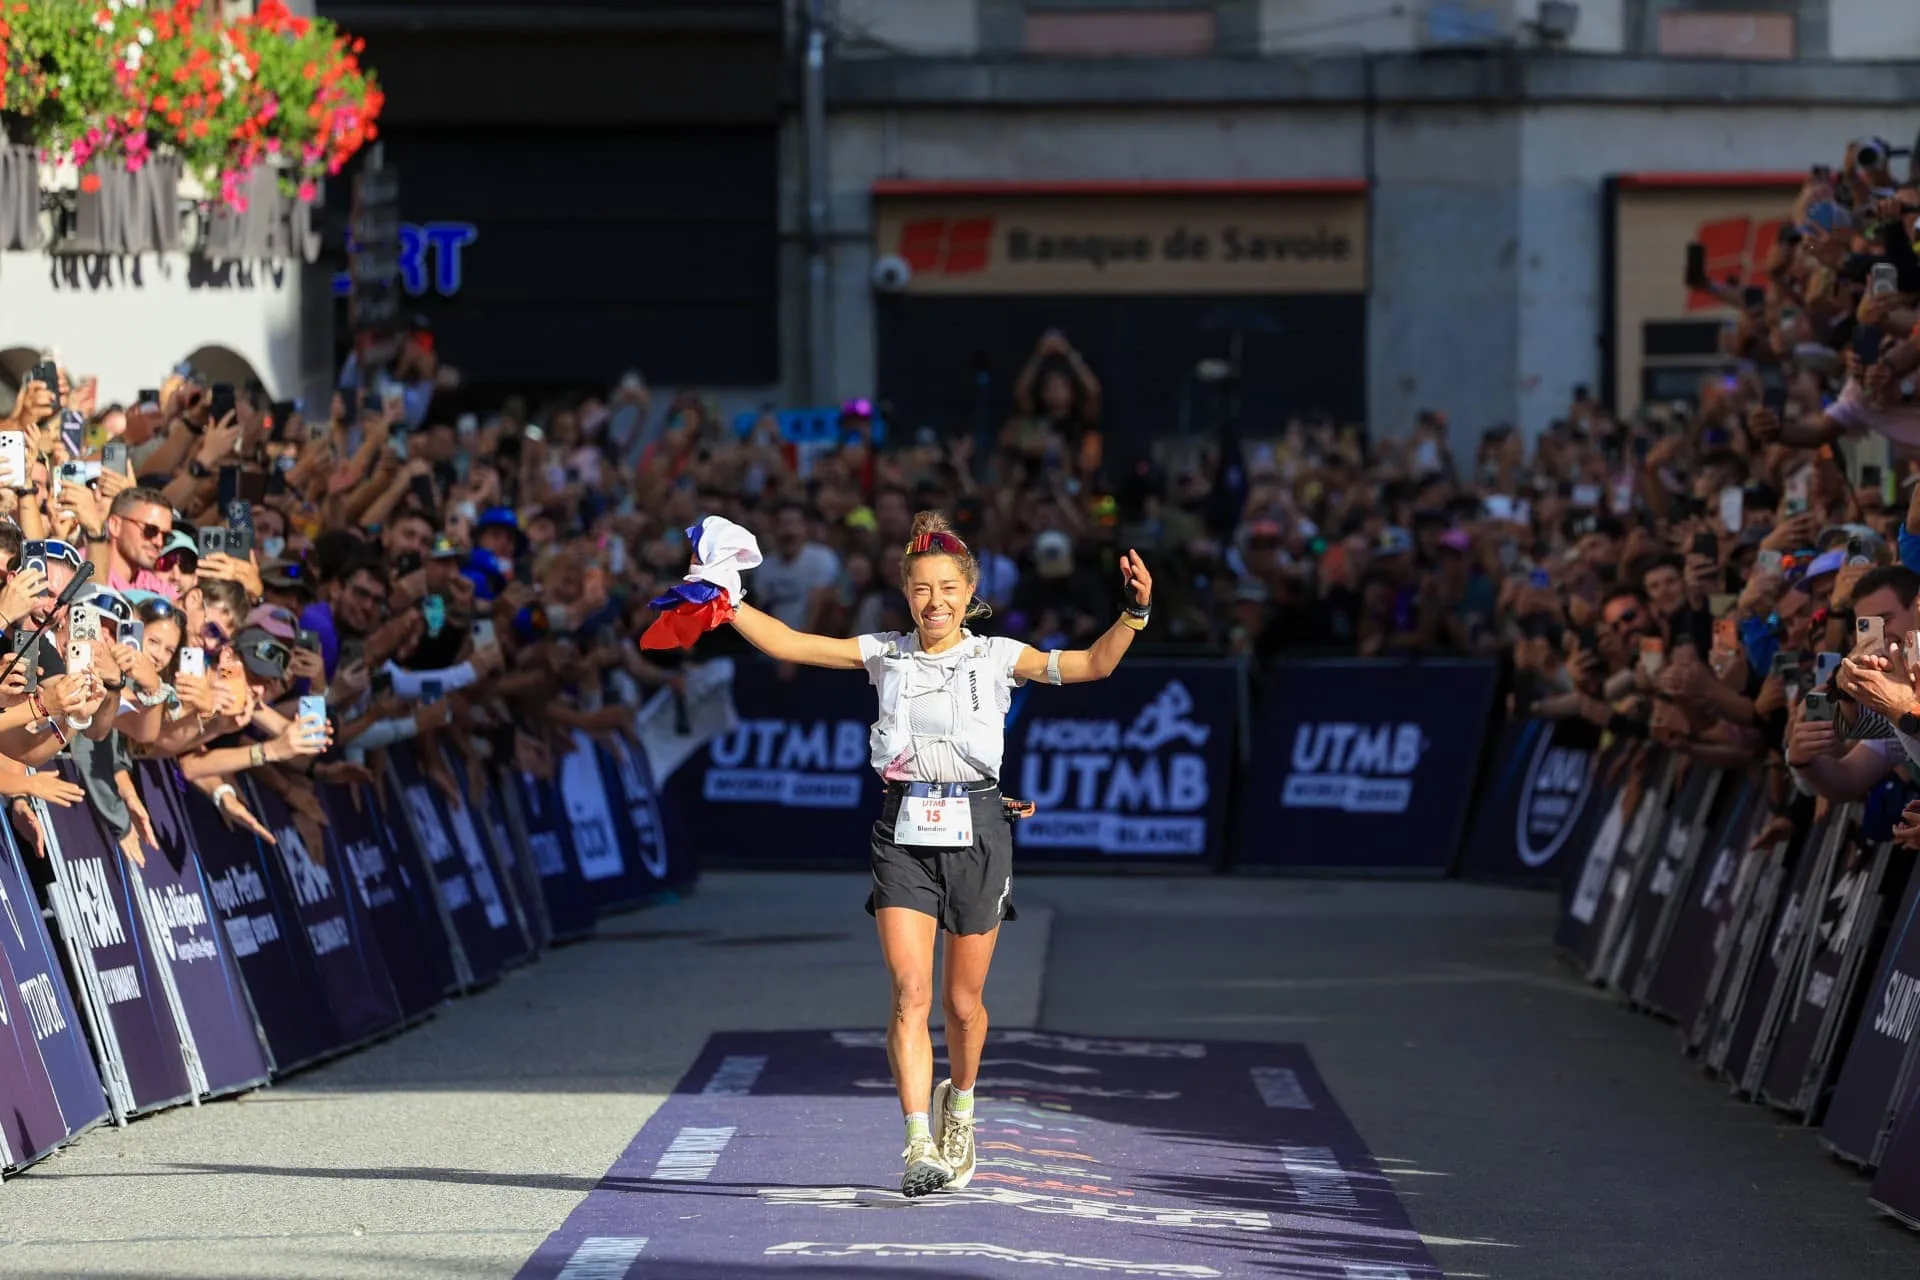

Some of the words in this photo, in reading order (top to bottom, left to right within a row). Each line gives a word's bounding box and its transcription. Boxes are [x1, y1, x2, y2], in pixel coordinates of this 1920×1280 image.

[1007, 226, 1149, 271] Banque
[1163, 225, 1206, 261] de
[1223, 225, 1352, 262] Savoie
[709, 718, 865, 771] UTMB
[1024, 717, 1121, 752] HOKA
[1289, 720, 1424, 776] UTMB
[922, 799, 947, 808] UTMB
[1019, 752, 1210, 814] UTMB
[926, 809, 942, 823] 15
[19, 971, 67, 1041] TUDOR
